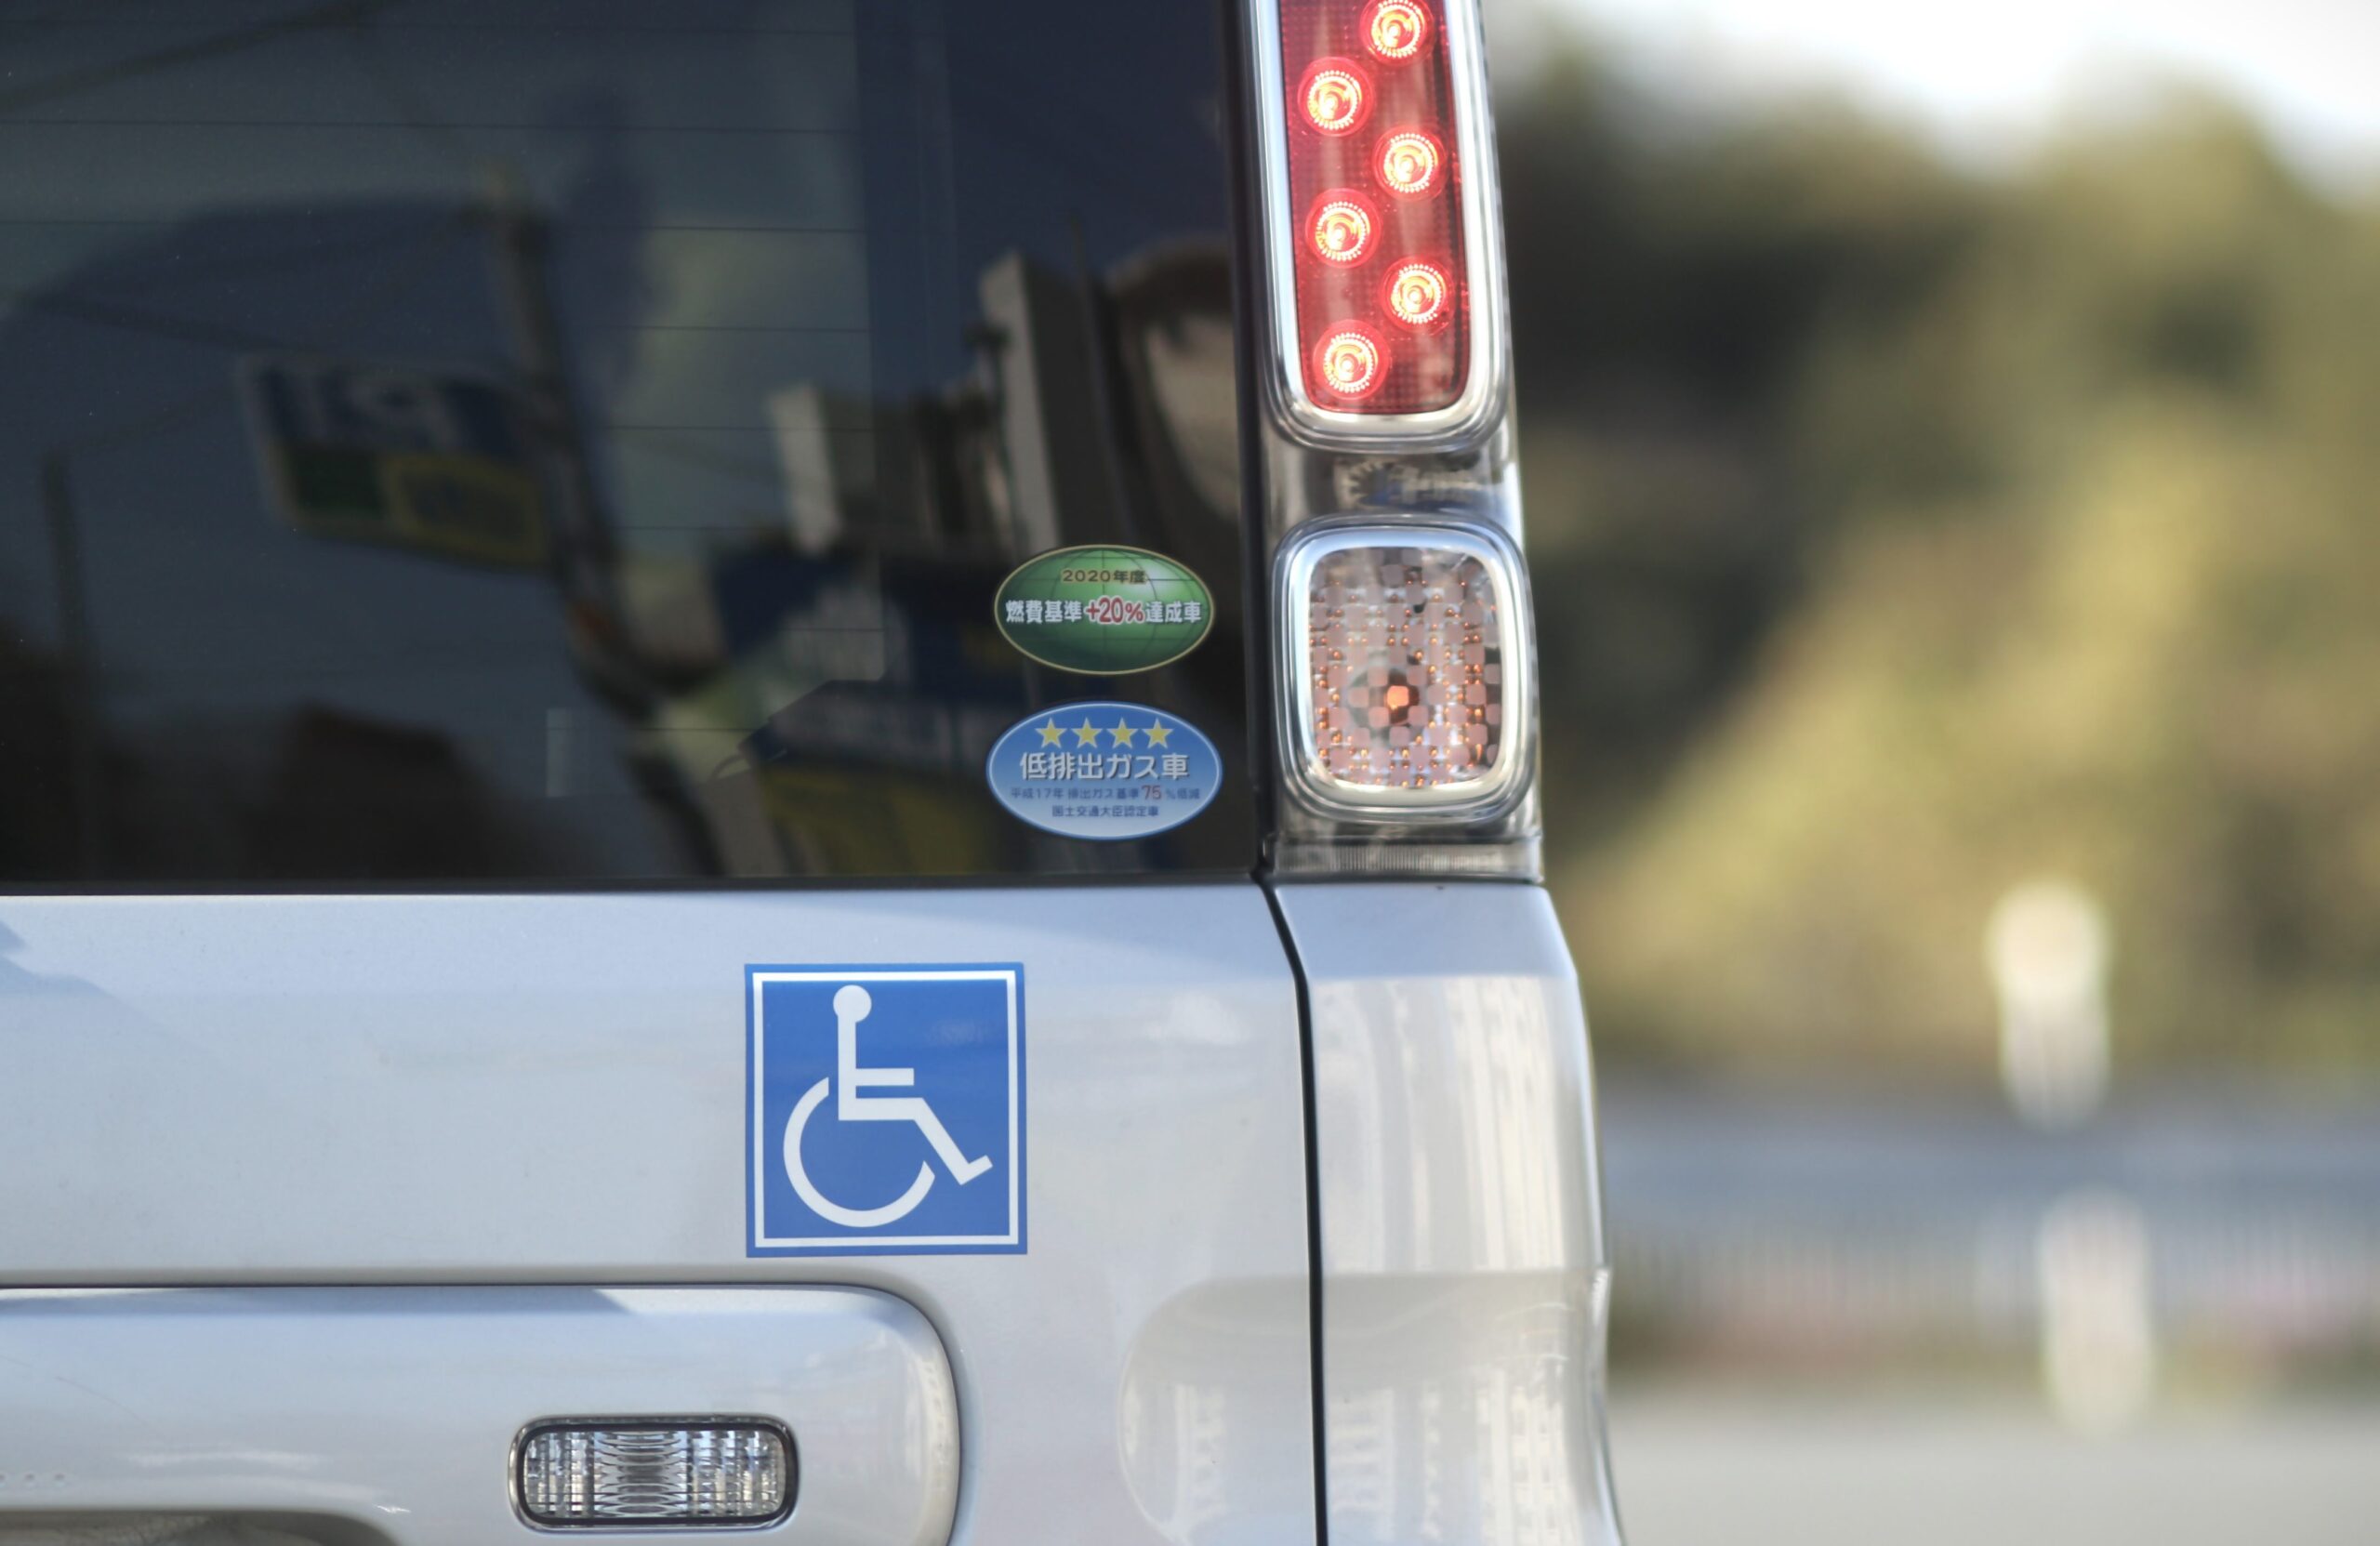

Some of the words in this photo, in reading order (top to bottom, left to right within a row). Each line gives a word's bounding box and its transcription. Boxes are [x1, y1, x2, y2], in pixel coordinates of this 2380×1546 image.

[1062, 570, 1147, 584] 2020年度
[1020, 751, 1190, 781] 低排出ガス車
